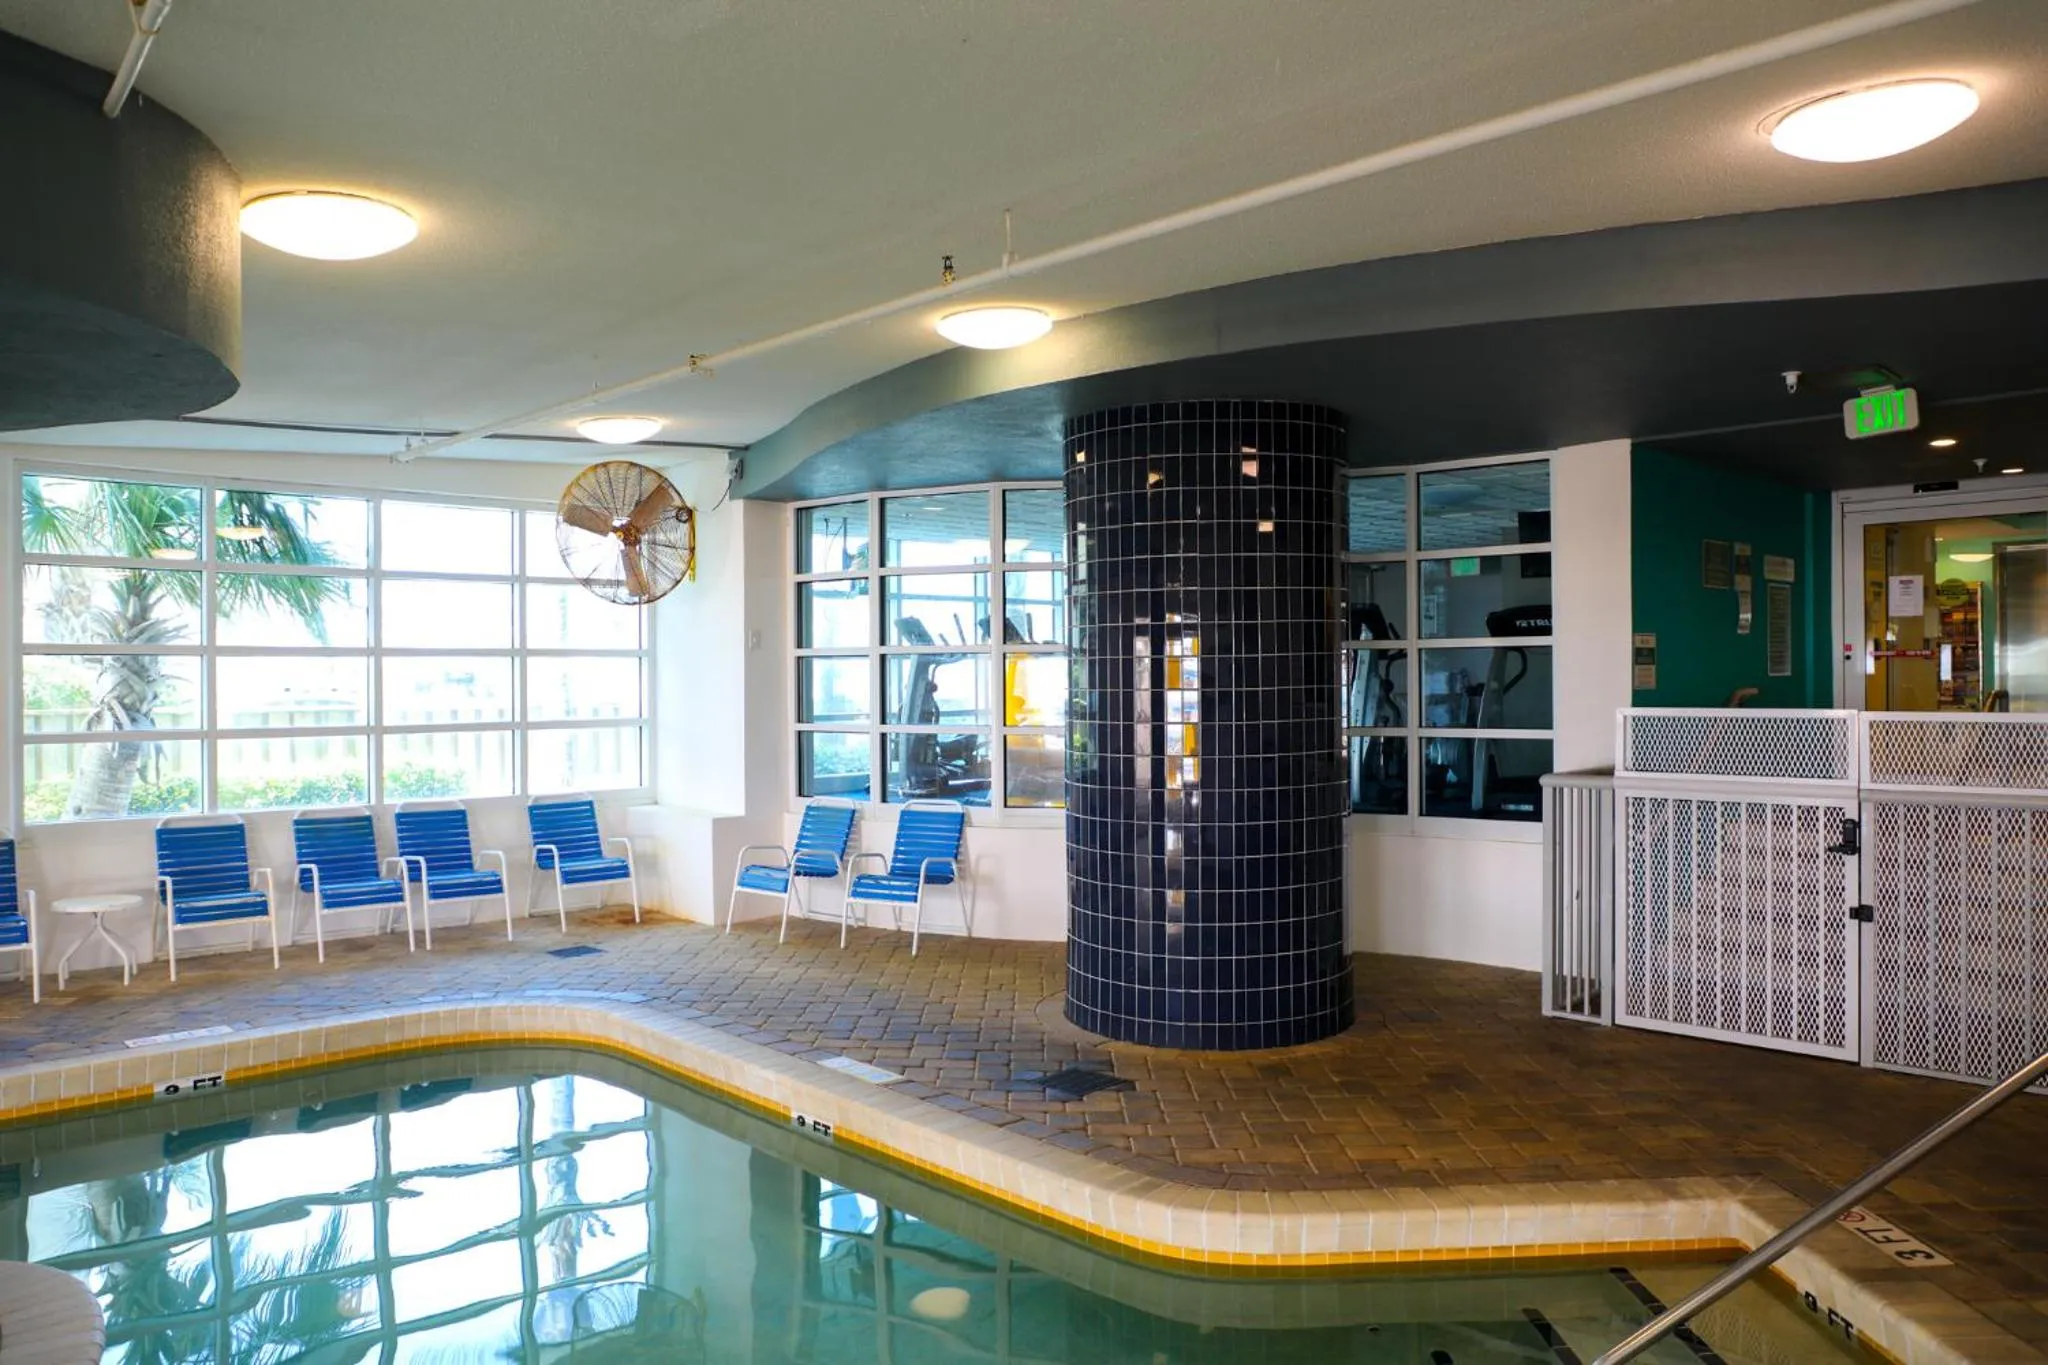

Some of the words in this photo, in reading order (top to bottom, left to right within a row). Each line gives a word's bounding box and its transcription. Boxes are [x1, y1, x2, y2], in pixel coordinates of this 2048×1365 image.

[1856, 391, 1905, 432] EXIT
[193, 1076, 222, 1090] FT
[797, 1115, 806, 1127] 9
[813, 1120, 831, 1136] FT
[1855, 1227, 1909, 1244] FT
[1895, 1250, 1935, 1260] 3
[1828, 1308, 1854, 1340] FT
